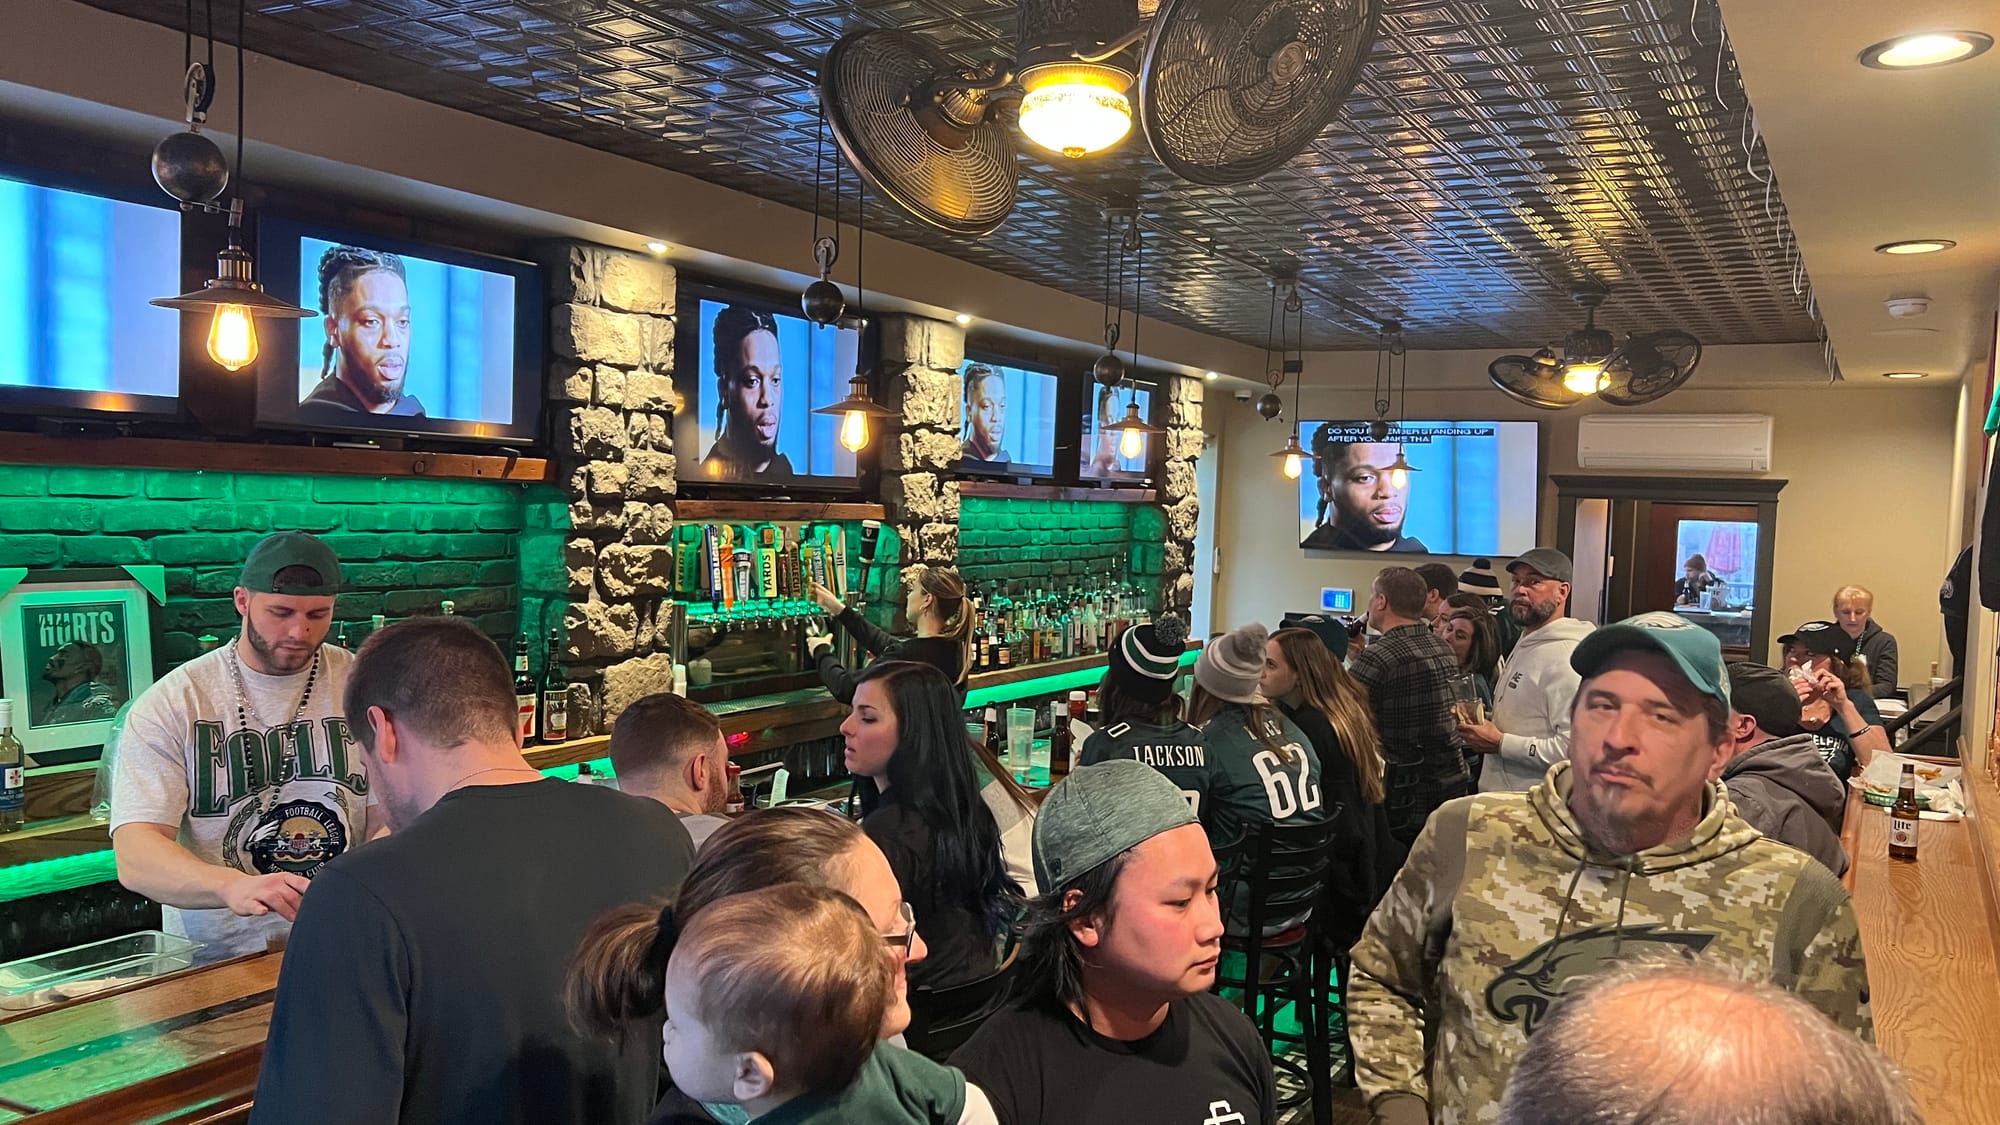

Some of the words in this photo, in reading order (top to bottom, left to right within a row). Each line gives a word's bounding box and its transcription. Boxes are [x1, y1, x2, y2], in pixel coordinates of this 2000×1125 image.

[711, 536, 720, 567] LIGHT
[714, 568, 722, 591] BUD
[762, 554, 772, 592] YARDS
[39, 611, 115, 647] HURTS
[1132, 745, 1205, 767] JACKSON
[1252, 742, 1321, 819] 62
[284, 806, 324, 820] FOOTBALL
[323, 818, 340, 845] LEAGUE
[1893, 820, 1912, 830] Lite
